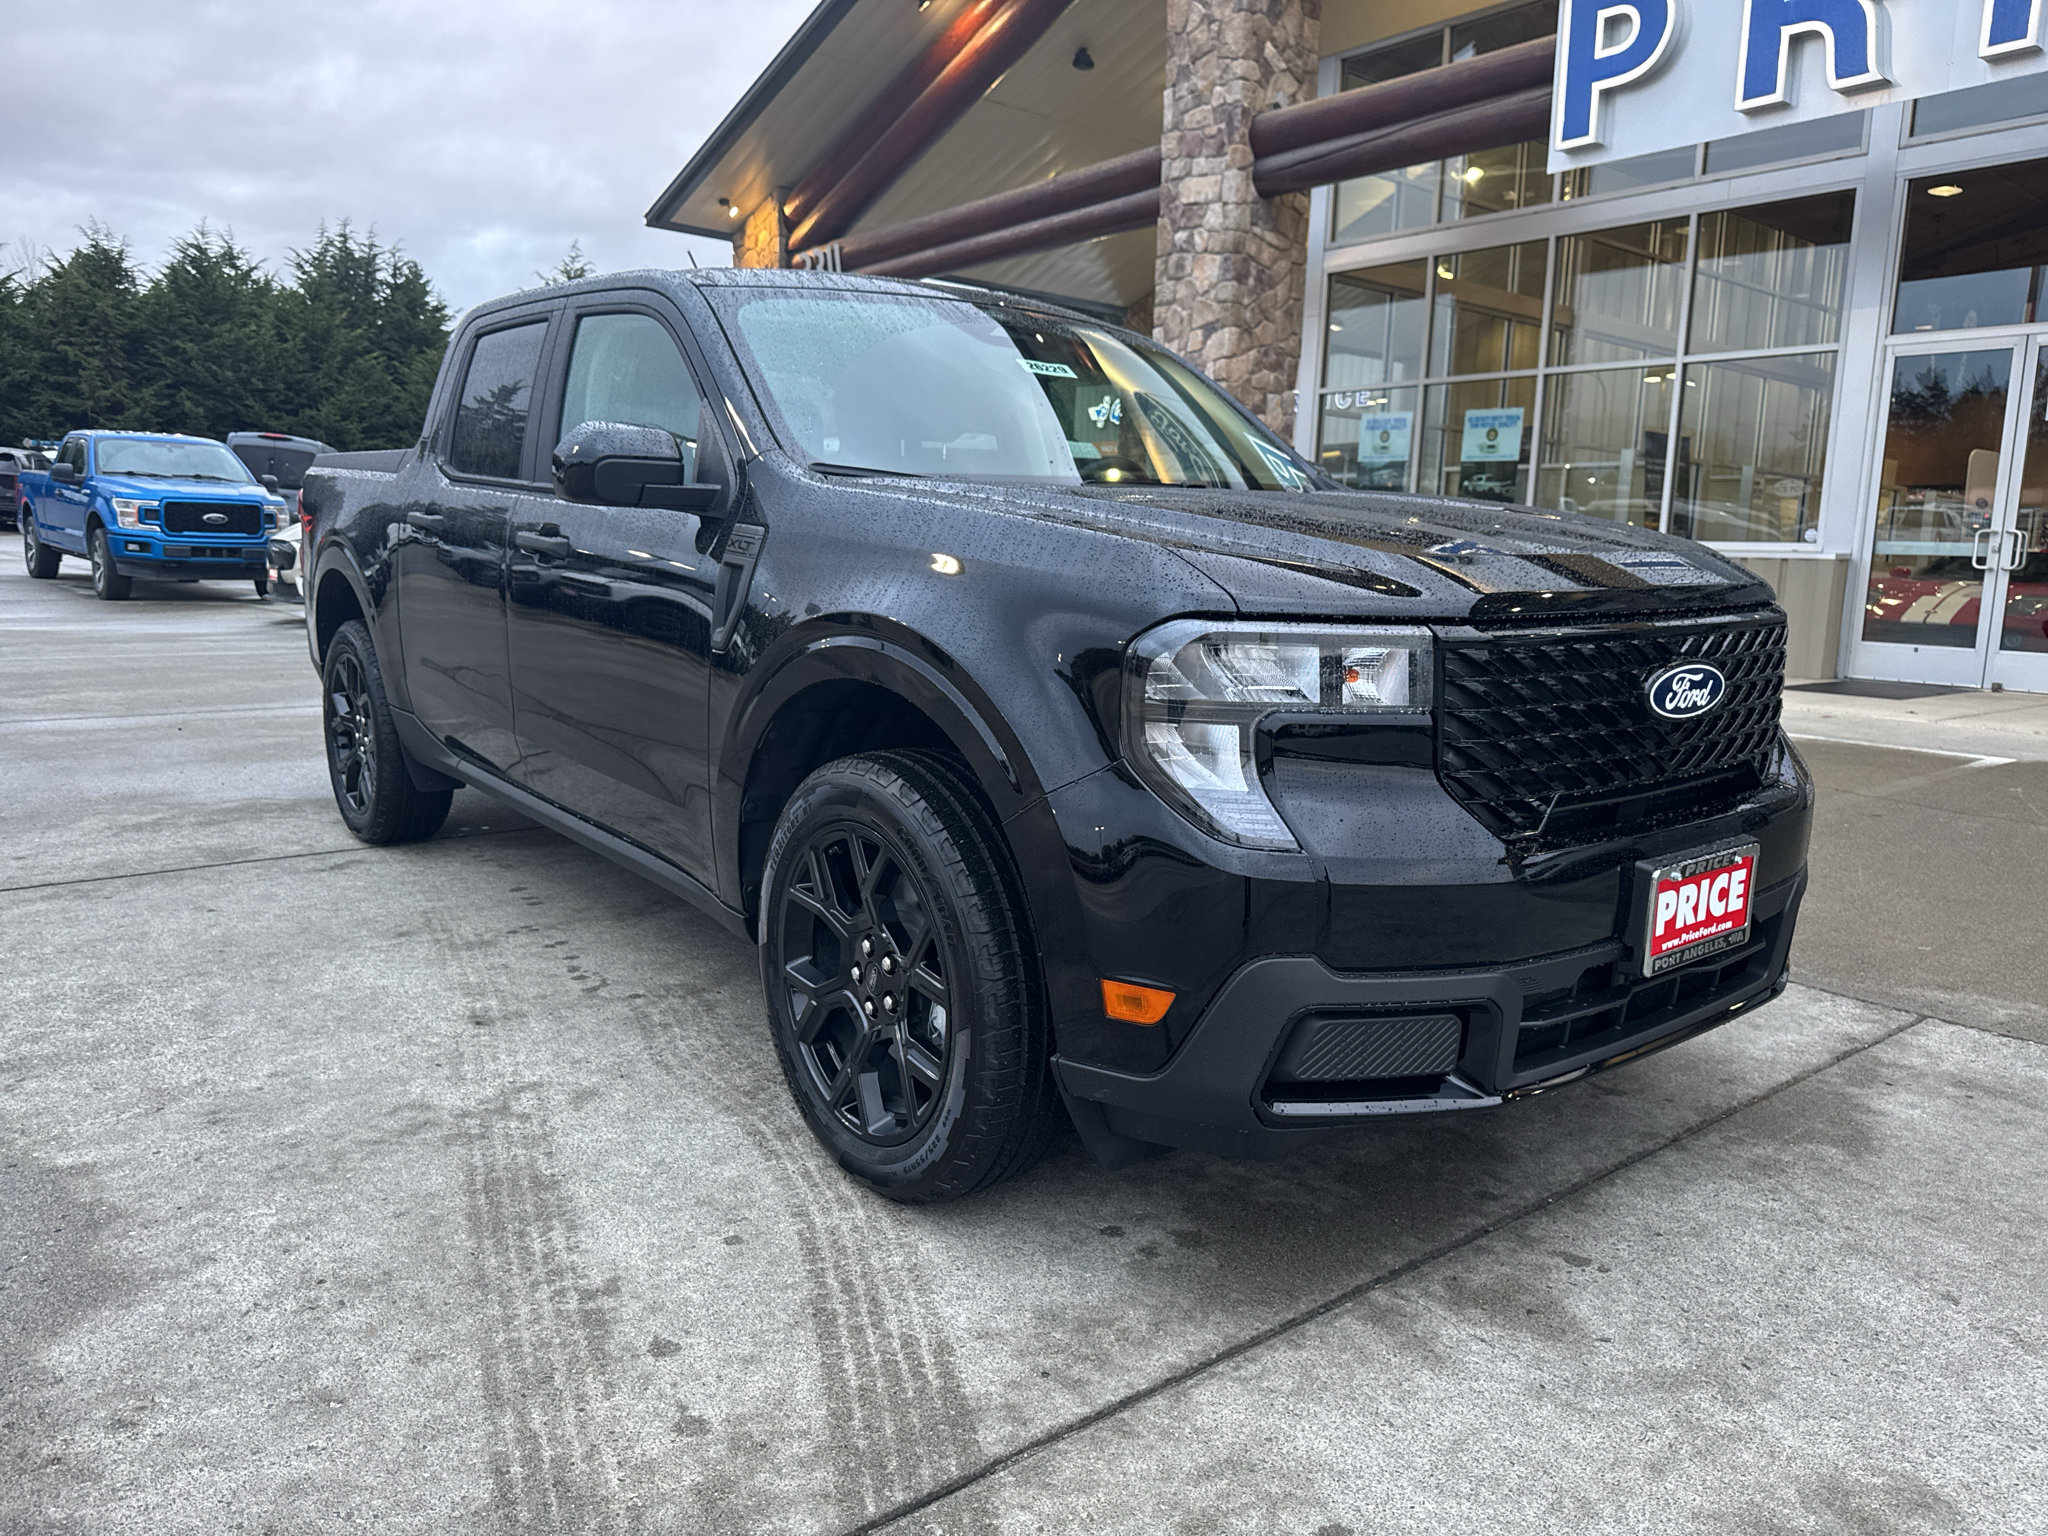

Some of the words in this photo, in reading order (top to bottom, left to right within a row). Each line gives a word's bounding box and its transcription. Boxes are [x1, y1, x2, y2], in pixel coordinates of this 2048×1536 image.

[727, 537, 756, 552] XLT
[1665, 672, 1713, 711] Ford
[1685, 855, 1730, 877] PRICE
[1655, 868, 1747, 937] PRICE
[1654, 952, 1682, 971] PORT
[1683, 937, 1727, 961] ANGELES,
[1728, 932, 1744, 944] WA
[1661, 921, 1733, 951] www.PriceFord.com
[903, 1133, 941, 1175] 225/55R19
